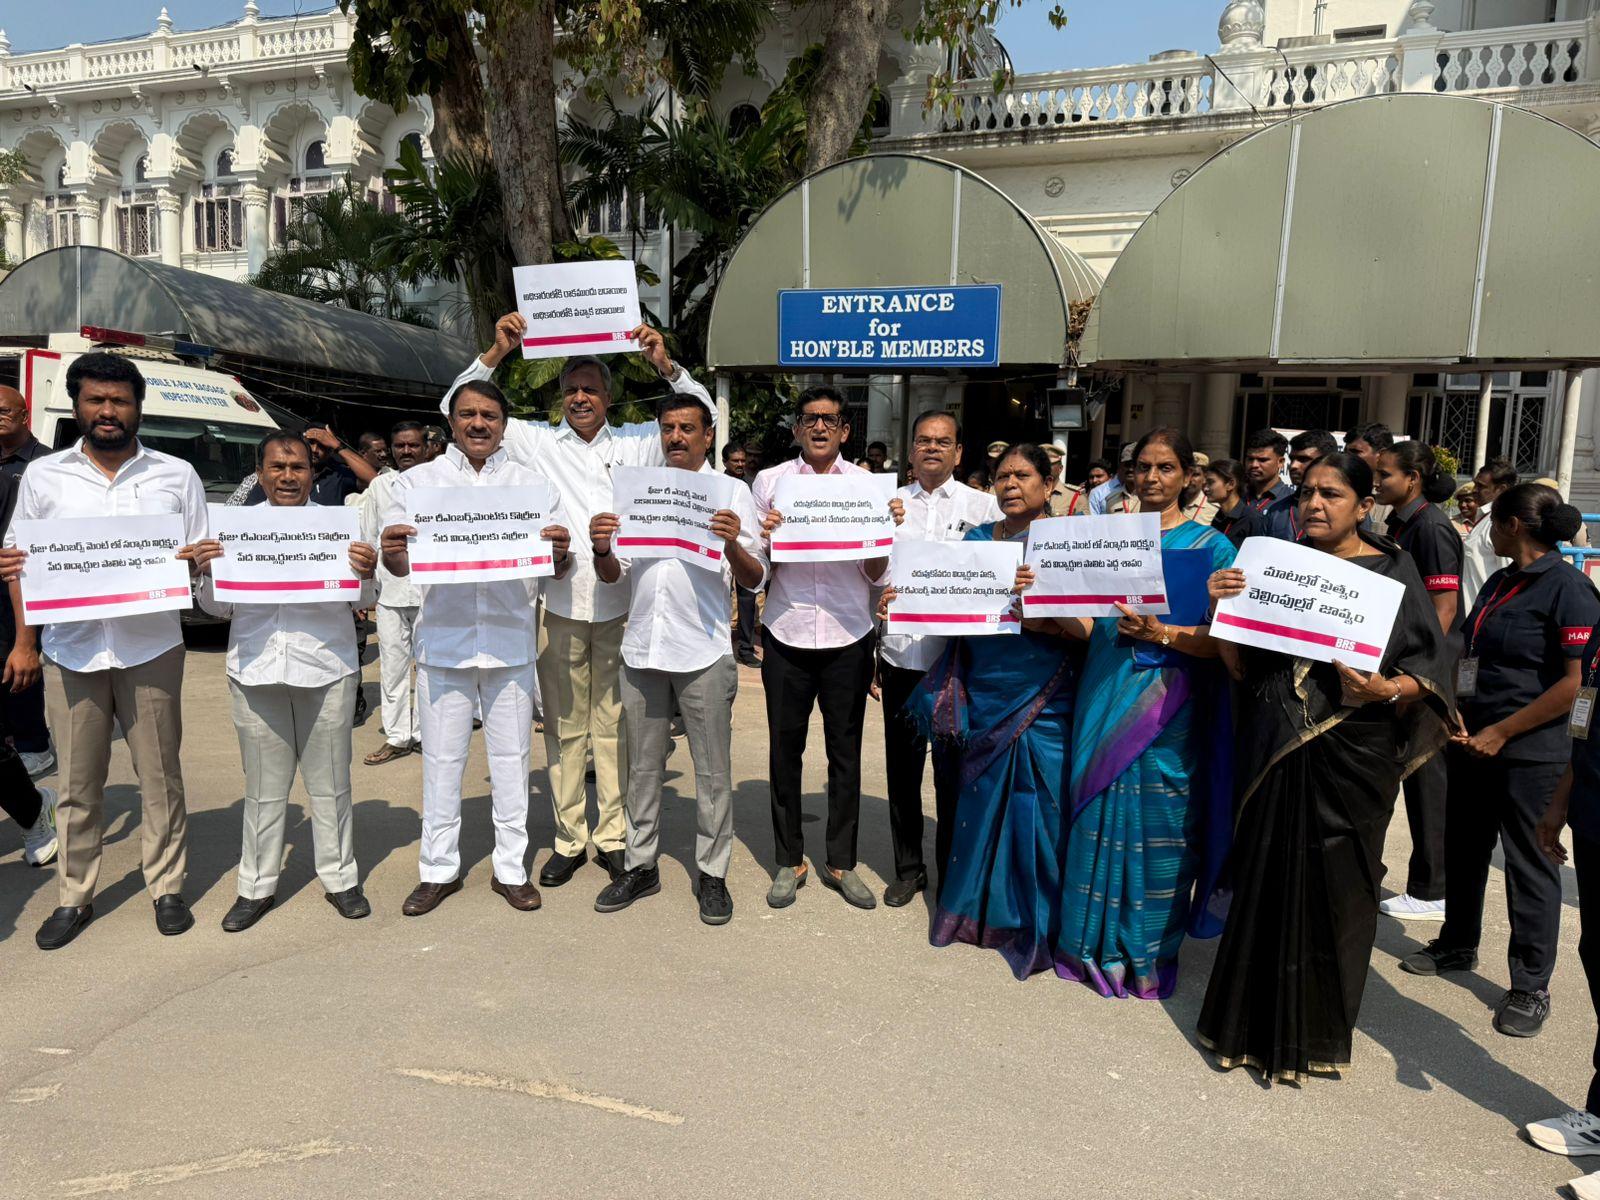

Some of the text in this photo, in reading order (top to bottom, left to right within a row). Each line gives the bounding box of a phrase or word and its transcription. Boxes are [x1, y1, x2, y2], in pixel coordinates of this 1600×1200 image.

[822, 293, 955, 313] ENTRANCE
[869, 318, 901, 336] for
[612, 332, 626, 340] BRS
[791, 339, 984, 357] HON'BLE MEMBERS
[171, 379, 193, 390] X-RAY
[193, 383, 227, 395] BAGGAGE
[160, 392, 229, 407] INSPECTION SYSTEM
[432, 533, 448, 542] పేద
[111, 539, 122, 549] లో
[1093, 539, 1103, 549] లో
[237, 552, 253, 562] పేద
[517, 557, 532, 566] BRS
[48, 561, 62, 571] పేద
[1041, 559, 1051, 568] పేద
[1121, 559, 1142, 568] శాపం
[324, 580, 340, 589] BRS
[1264, 566, 1359, 599] మాటల్లో పైత్యం
[149, 589, 167, 598] BRS
[1126, 595, 1143, 604] BRS
[1249, 587, 1365, 625] చెల్లింపుల్లో జాప్యం
[986, 614, 1000, 622] BRS
[1335, 638, 1356, 651] BRS
